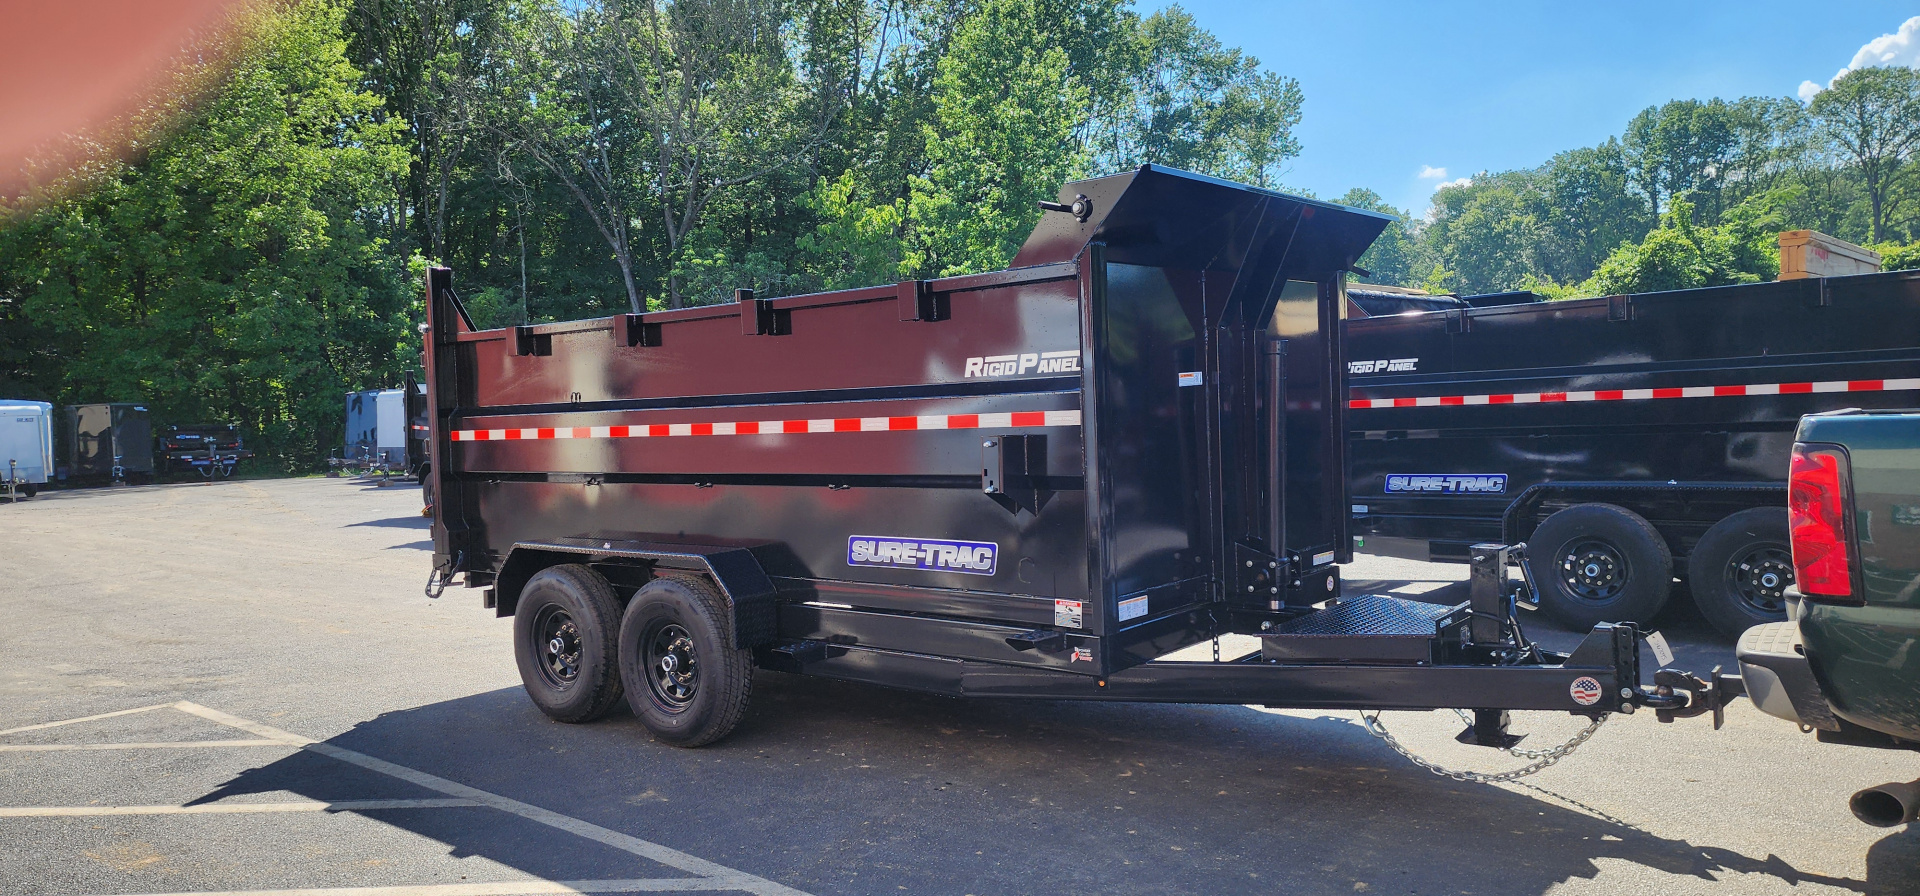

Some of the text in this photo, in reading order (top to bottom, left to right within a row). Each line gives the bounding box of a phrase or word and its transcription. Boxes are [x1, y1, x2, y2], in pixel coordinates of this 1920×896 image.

[964, 351, 1081, 378] RIGID PANEL
[1374, 359, 1418, 373] PANEL
[1388, 476, 1504, 493] SURE-TRAC
[851, 539, 993, 571] SURE-TRAC
